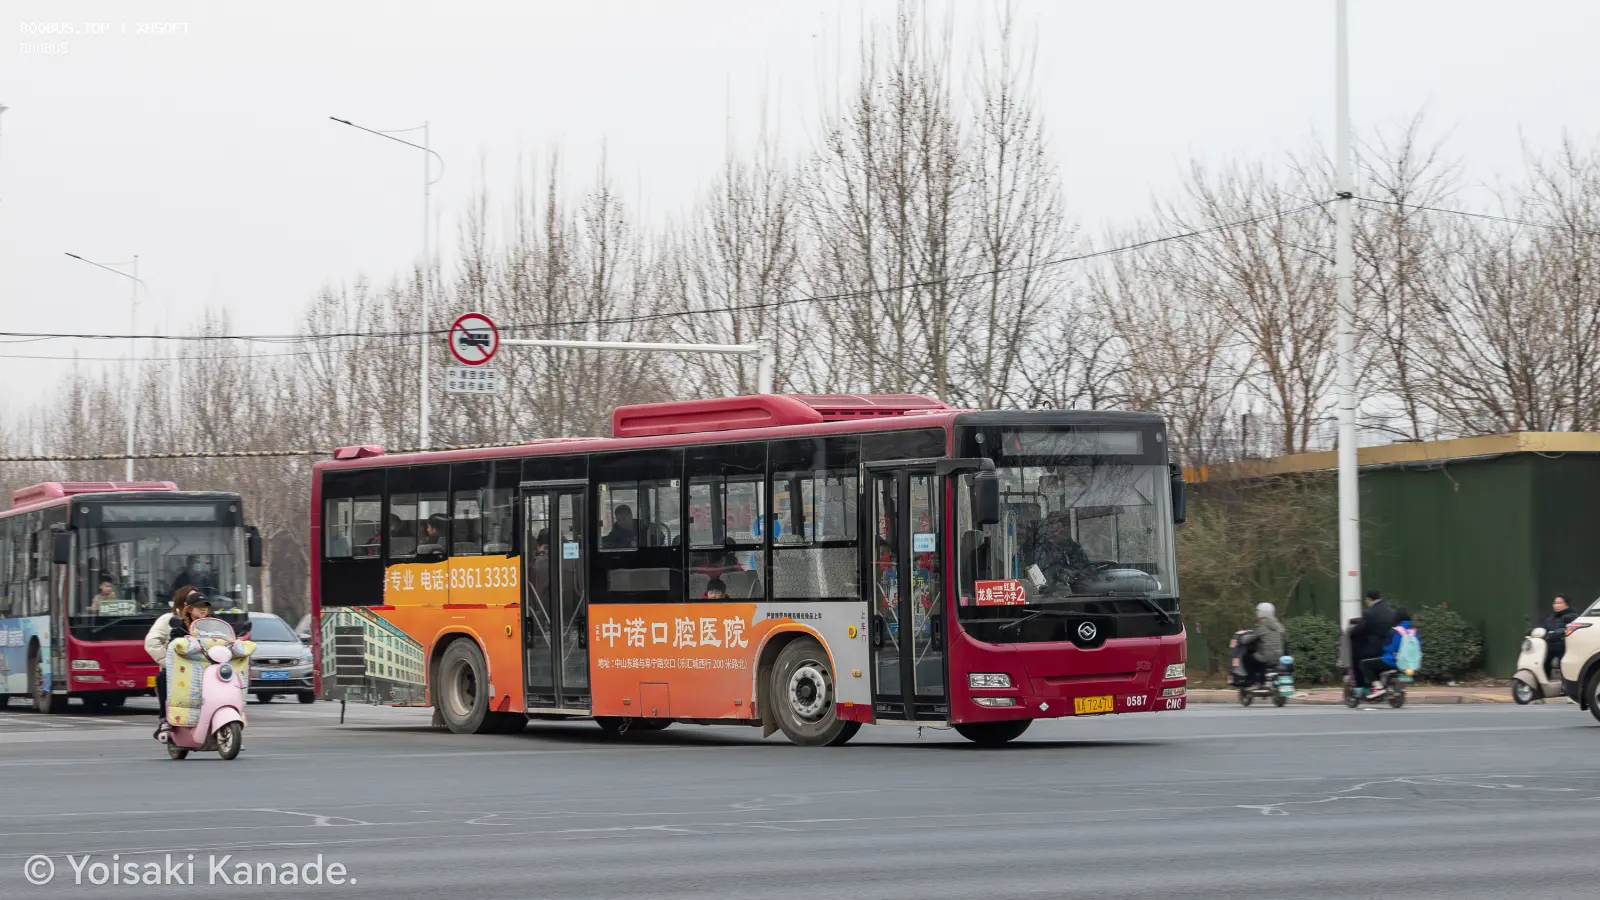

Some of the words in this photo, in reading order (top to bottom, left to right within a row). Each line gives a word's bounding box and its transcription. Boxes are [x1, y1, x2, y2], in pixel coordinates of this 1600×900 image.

[1017, 586, 1024, 602] 2
[602, 615, 749, 649] 中诺口腔医院
[1126, 695, 1148, 707] 0587
[1166, 698, 1182, 710] CNG
